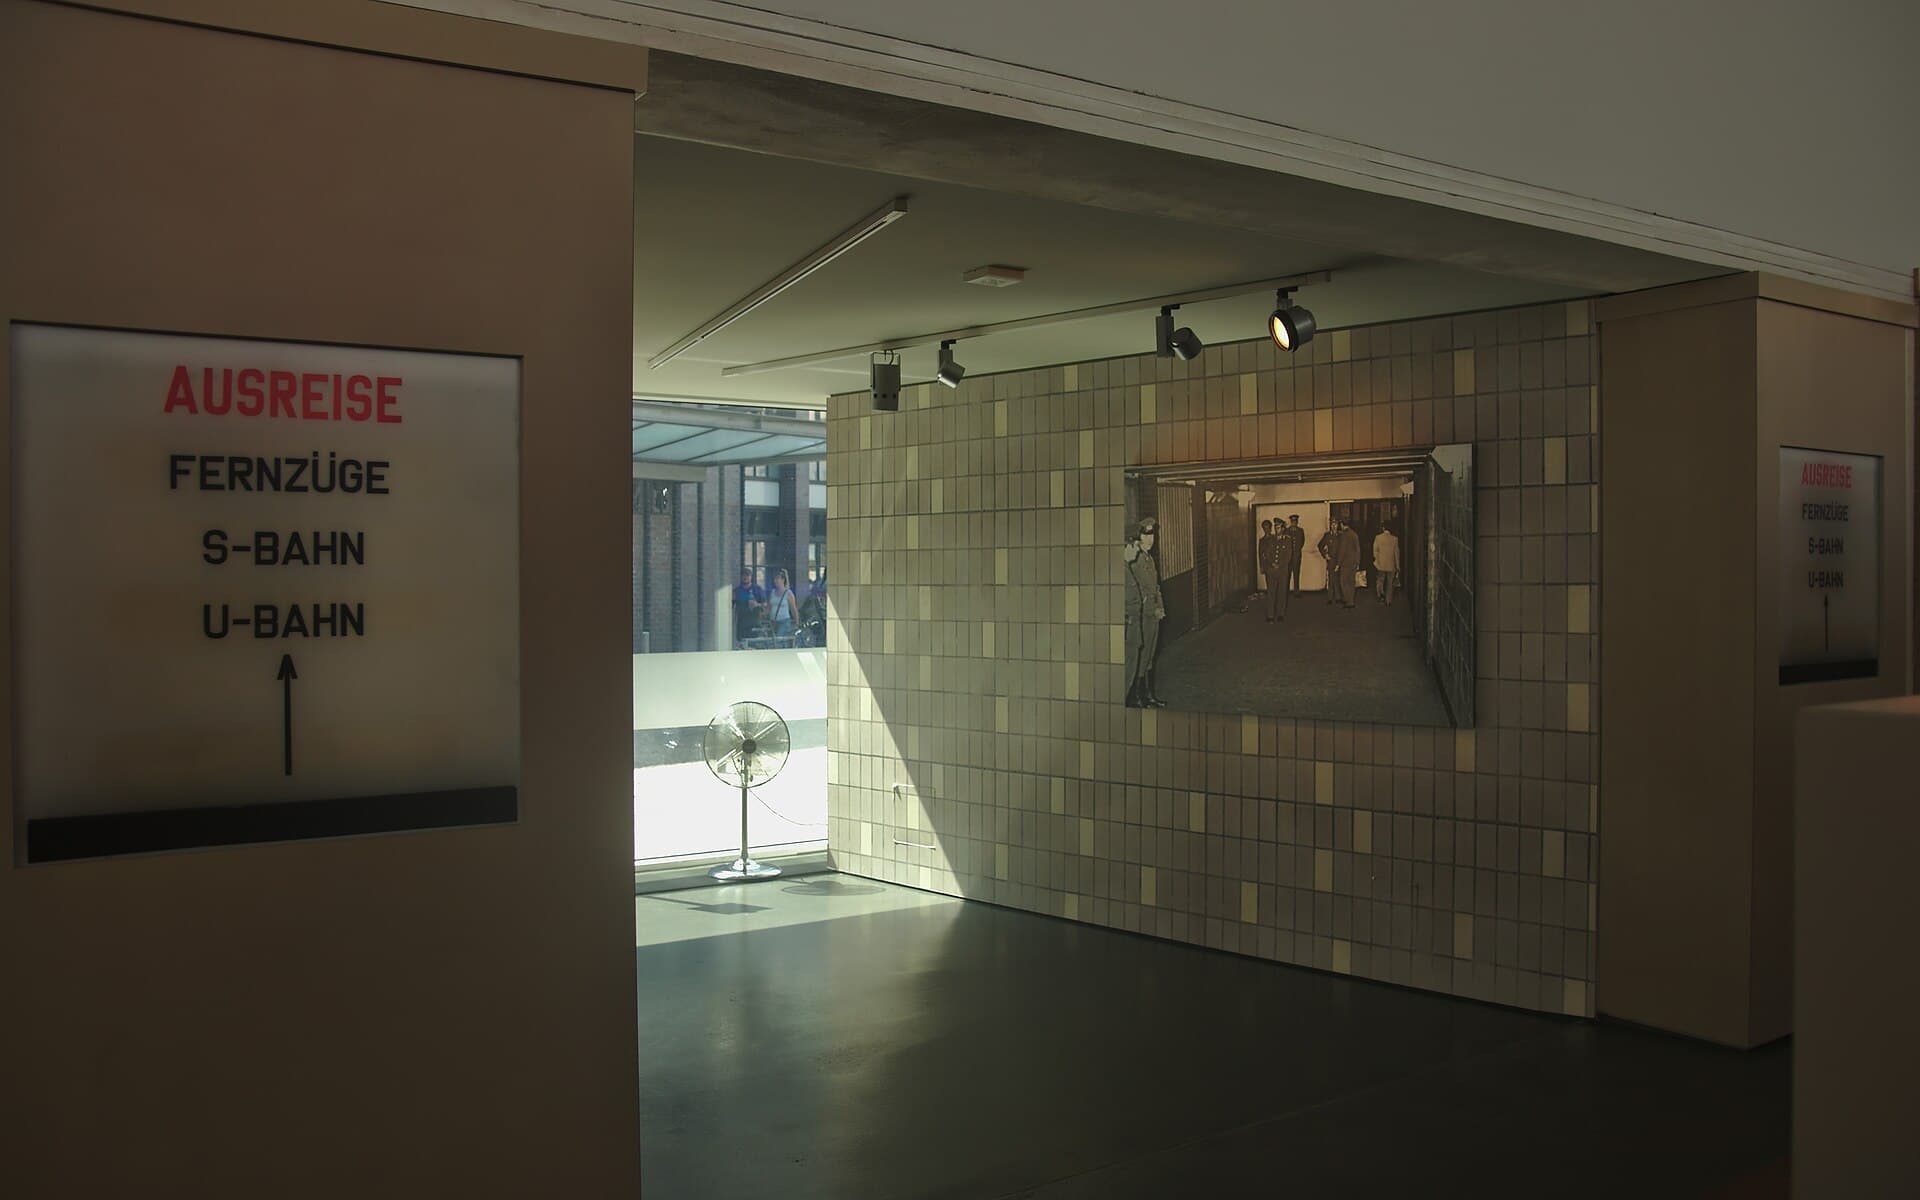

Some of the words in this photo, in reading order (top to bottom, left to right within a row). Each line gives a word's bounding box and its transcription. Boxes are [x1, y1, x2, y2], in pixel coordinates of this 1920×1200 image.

[163, 364, 403, 424] AUSREISE
[169, 450, 390, 495] FERNZÜGE
[1801, 463, 1852, 489] AUSREISE
[1802, 501, 1849, 522] FERNZÜGE
[202, 529, 365, 566] S-BAHN
[1808, 537, 1844, 554] S-BAHN
[1808, 571, 1844, 588] U-BAHN
[202, 603, 365, 639] U-BAHN
